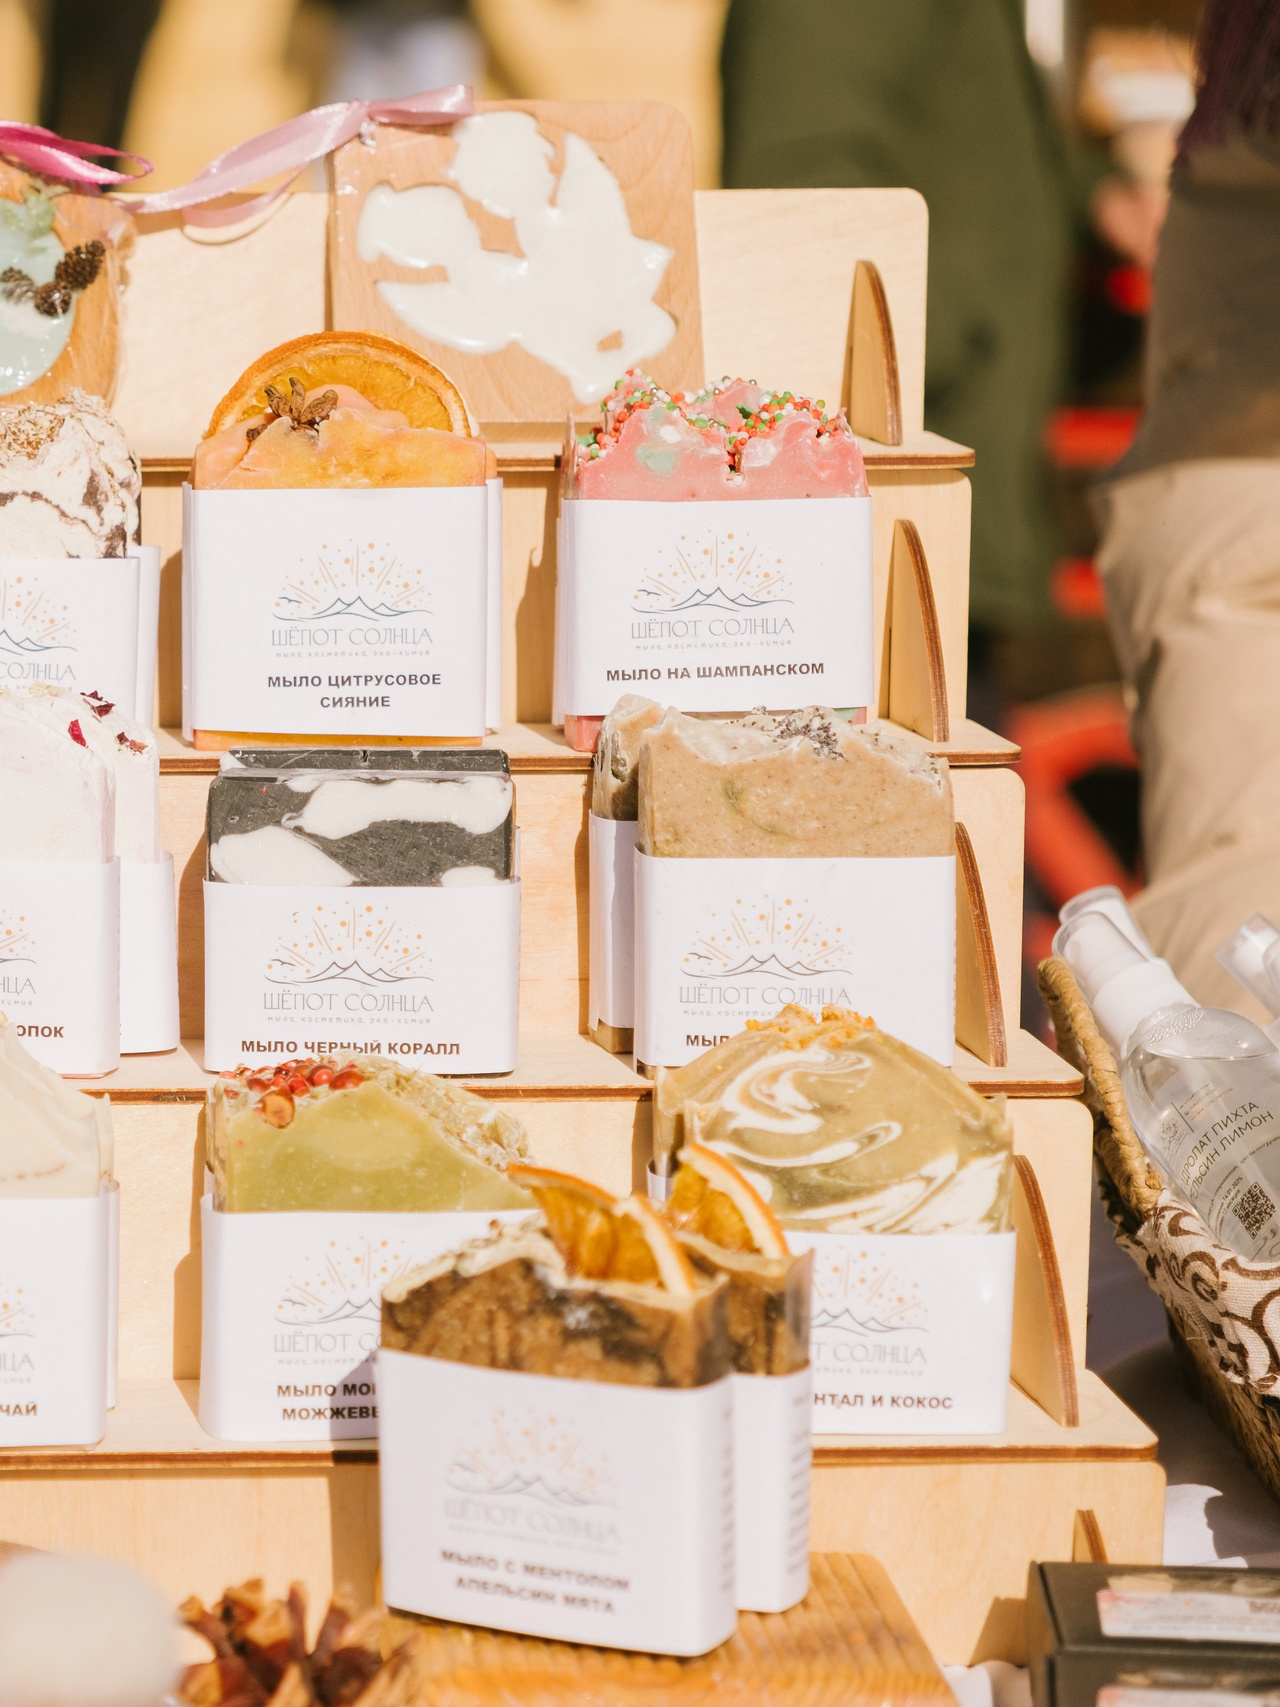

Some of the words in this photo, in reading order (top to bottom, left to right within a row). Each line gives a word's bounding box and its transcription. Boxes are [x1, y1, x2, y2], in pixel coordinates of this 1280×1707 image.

[272, 626, 343, 646] ШЁПОТ
[349, 627, 433, 647] СОЛНЦА
[631, 619, 703, 640] ШЁПОТ
[708, 617, 795, 637] СОЛНЦА
[267, 675, 322, 687] МЫЛО
[328, 673, 442, 688] ЦИТРУСОВОЕ
[606, 668, 661, 681] МЫЛО
[667, 667, 691, 679] НА
[696, 662, 825, 678] ШАМПАНСКОМ
[320, 696, 391, 708] СИЯНИЕ
[264, 989, 338, 1010] ШЁПОТ
[344, 994, 434, 1013] СОЛНЦА
[680, 984, 755, 1004] ШЁПОТ
[241, 1040, 297, 1053] МЫЛО
[304, 1040, 382, 1055] ЧЕРНЫЙ
[388, 1043, 460, 1055] КОРАЛЛ
[1211, 1101, 1259, 1136] ПИХТА
[1219, 1111, 1274, 1151] ЛИМОН
[274, 1331, 352, 1352] ШЁПОТ
[277, 1384, 337, 1397] МЫЛО
[0, 1401, 38, 1417] ЧАЙ
[872, 1395, 883, 1408] И
[890, 1396, 953, 1409] КОКОС
[440, 1549, 498, 1571] МЫЛО
[505, 1561, 517, 1574] С
[522, 1563, 631, 1591] МЕНТОЛОМ
[455, 1576, 558, 1605] АПЕЛЬСИН
[563, 1594, 616, 1614] МЯТА
